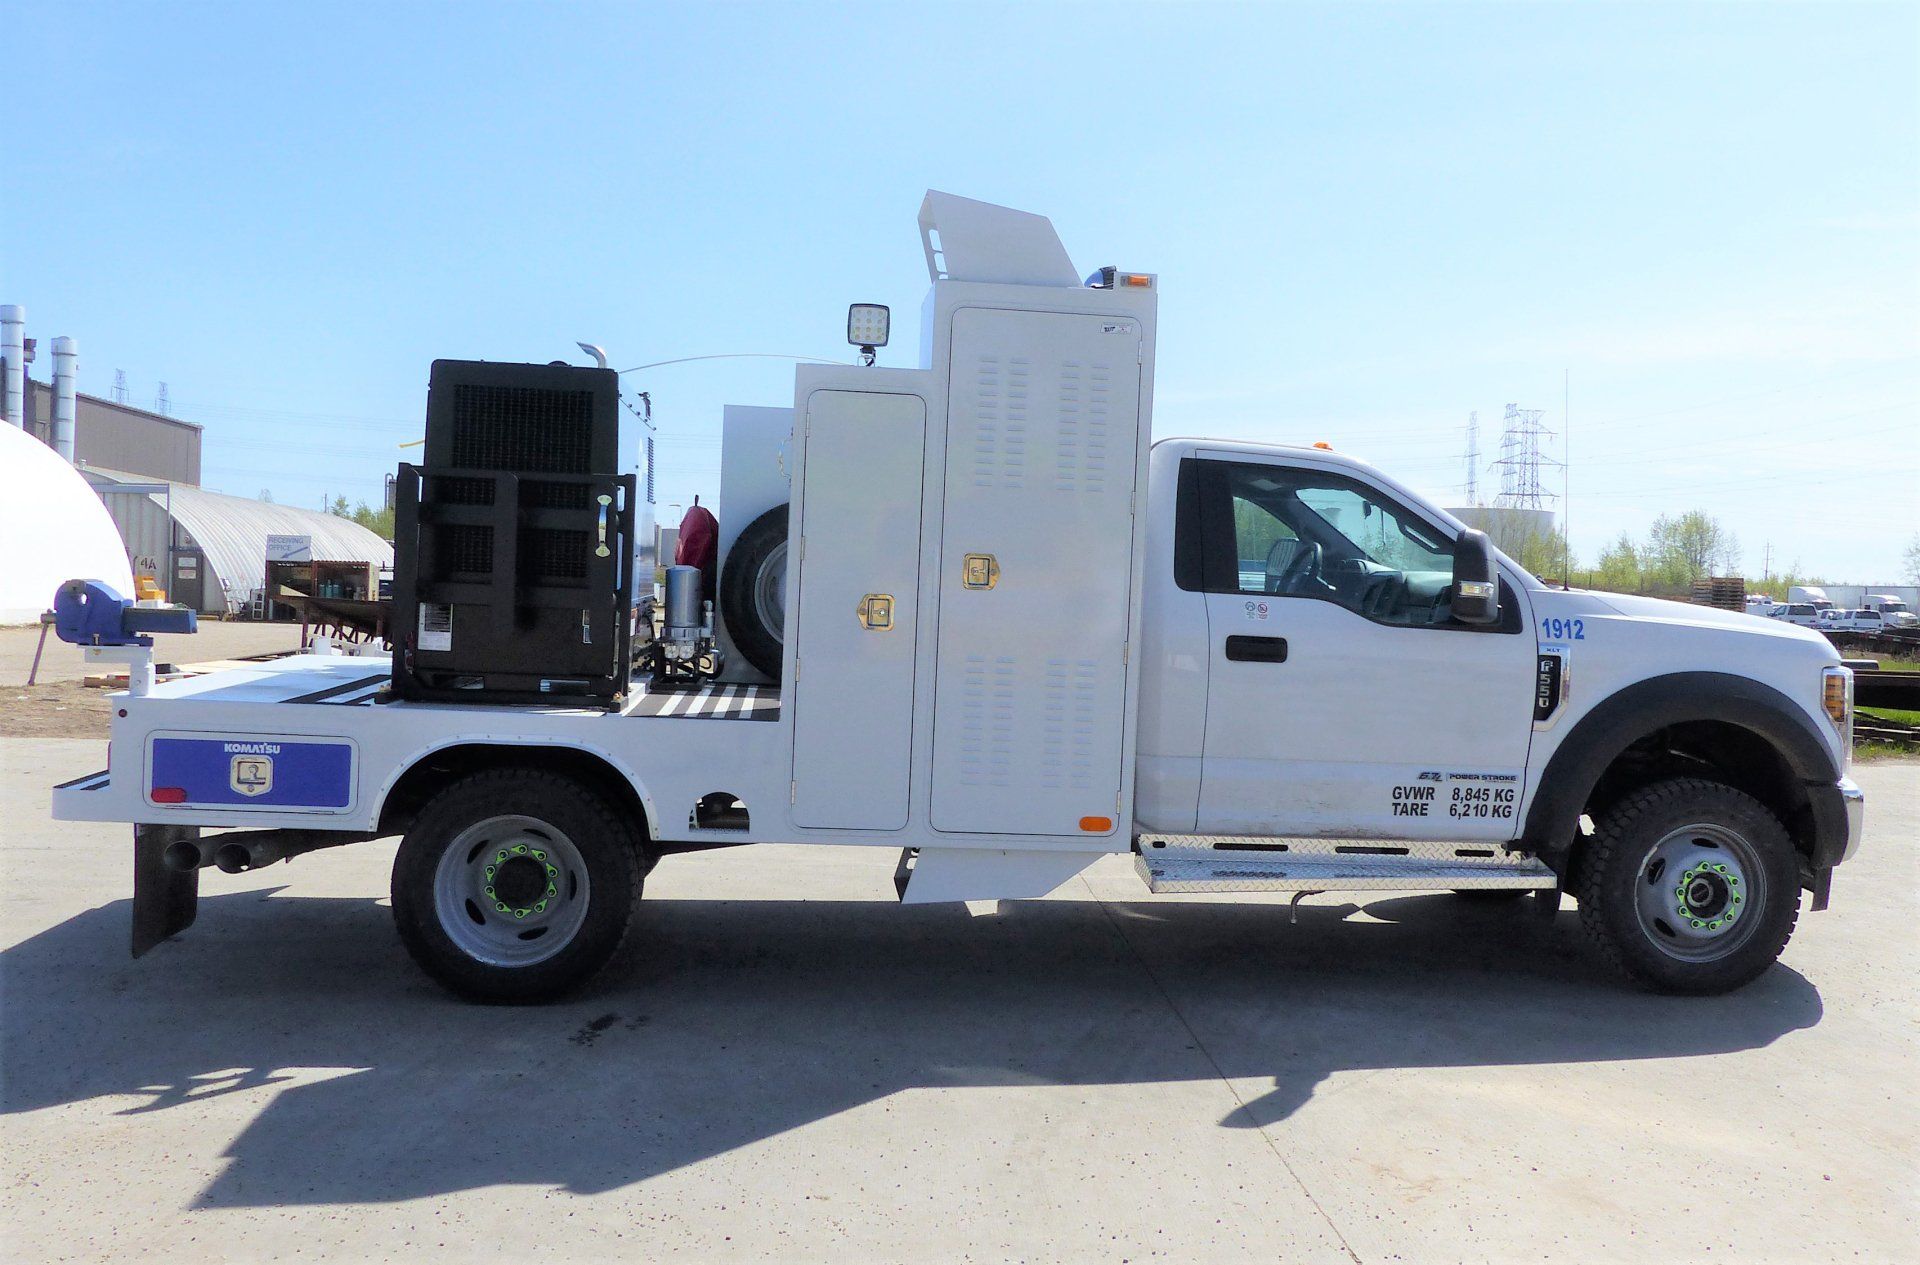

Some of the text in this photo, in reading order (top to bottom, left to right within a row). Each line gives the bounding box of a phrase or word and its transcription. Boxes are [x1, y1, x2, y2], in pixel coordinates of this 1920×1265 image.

[1542, 617, 1585, 640] 1912
[1538, 660, 1554, 708] F550
[224, 743, 281, 754] KOMATSU
[1392, 786, 1515, 803] GVWR 8,845 KG
[1392, 802, 1512, 820] TARE 6,210 KG
